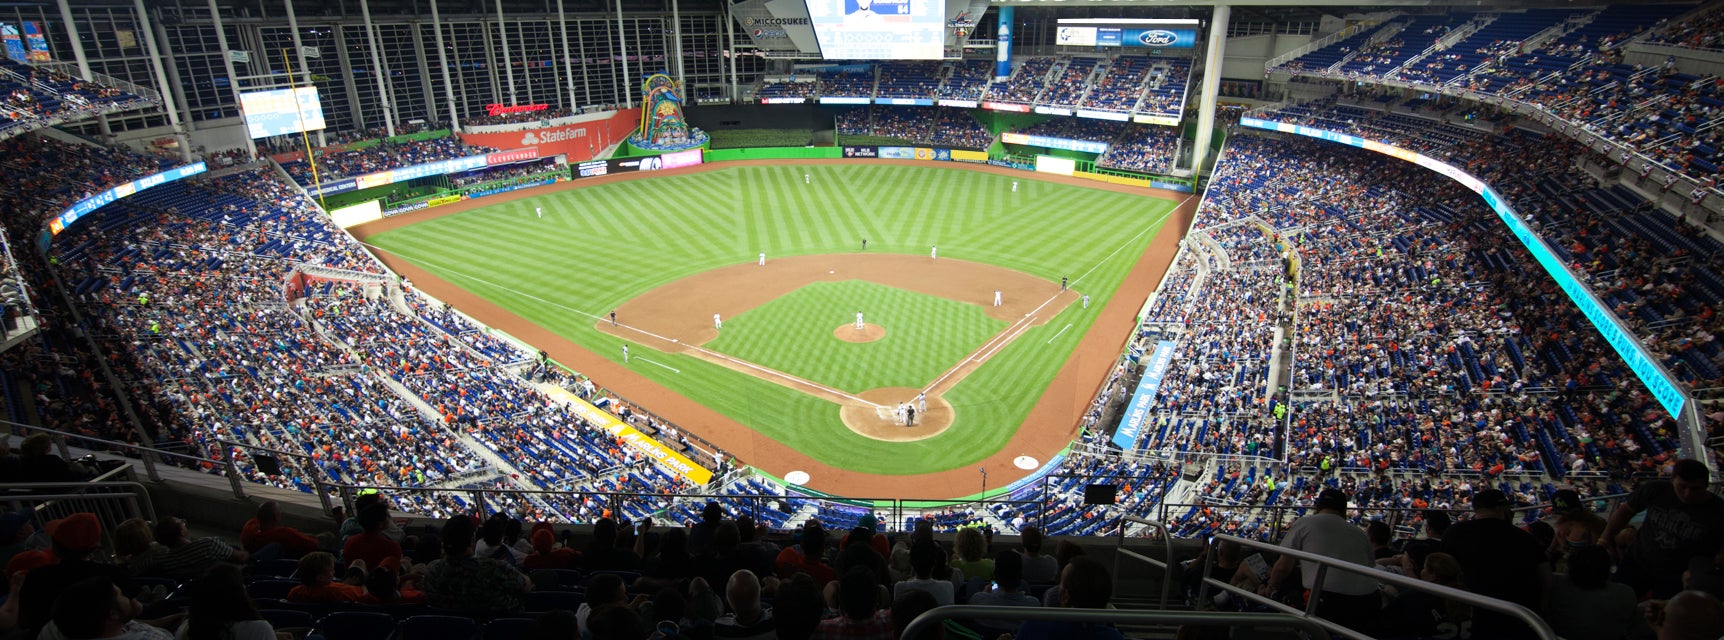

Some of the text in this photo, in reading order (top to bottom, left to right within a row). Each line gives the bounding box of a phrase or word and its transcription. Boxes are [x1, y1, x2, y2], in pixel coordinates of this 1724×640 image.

[754, 17, 808, 25] MICCOSUKEE
[1145, 32, 1170, 44] Ford
[486, 103, 548, 116] Budweiser
[1593, 309, 1613, 337] SCORE
[1637, 357, 1655, 381] YOU
[1652, 374, 1680, 413] SCORE
[664, 456, 694, 474] PARK
